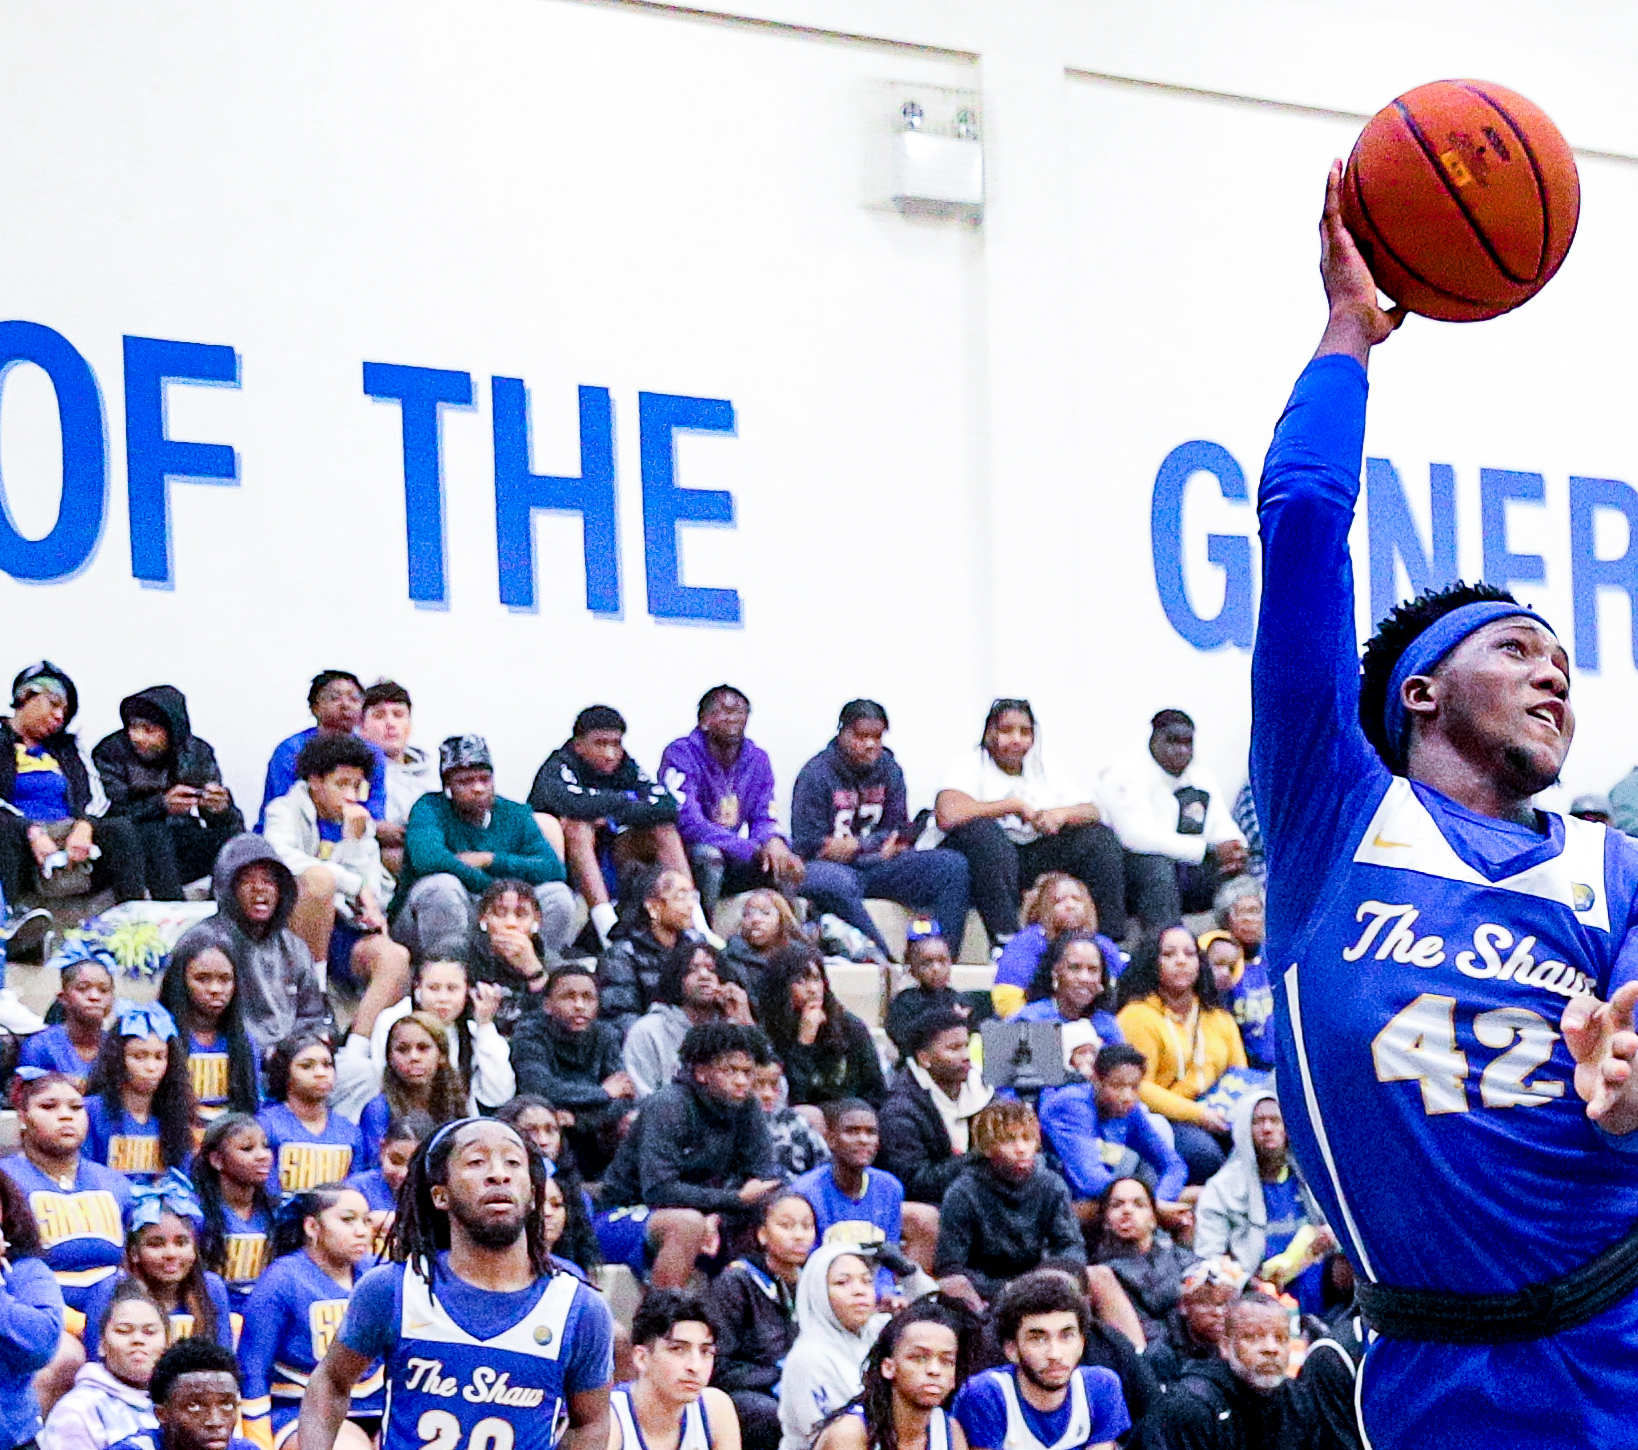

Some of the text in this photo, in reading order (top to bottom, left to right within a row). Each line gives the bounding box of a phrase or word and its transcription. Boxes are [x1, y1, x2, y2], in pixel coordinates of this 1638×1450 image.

[0, 319, 241, 591] OF
[362, 361, 744, 629] THE
[1343, 900, 1446, 969] The
[1370, 992, 1565, 1116] 42
[34, 1194, 122, 1244] SHAW
[405, 1357, 545, 1408] The Shaw
